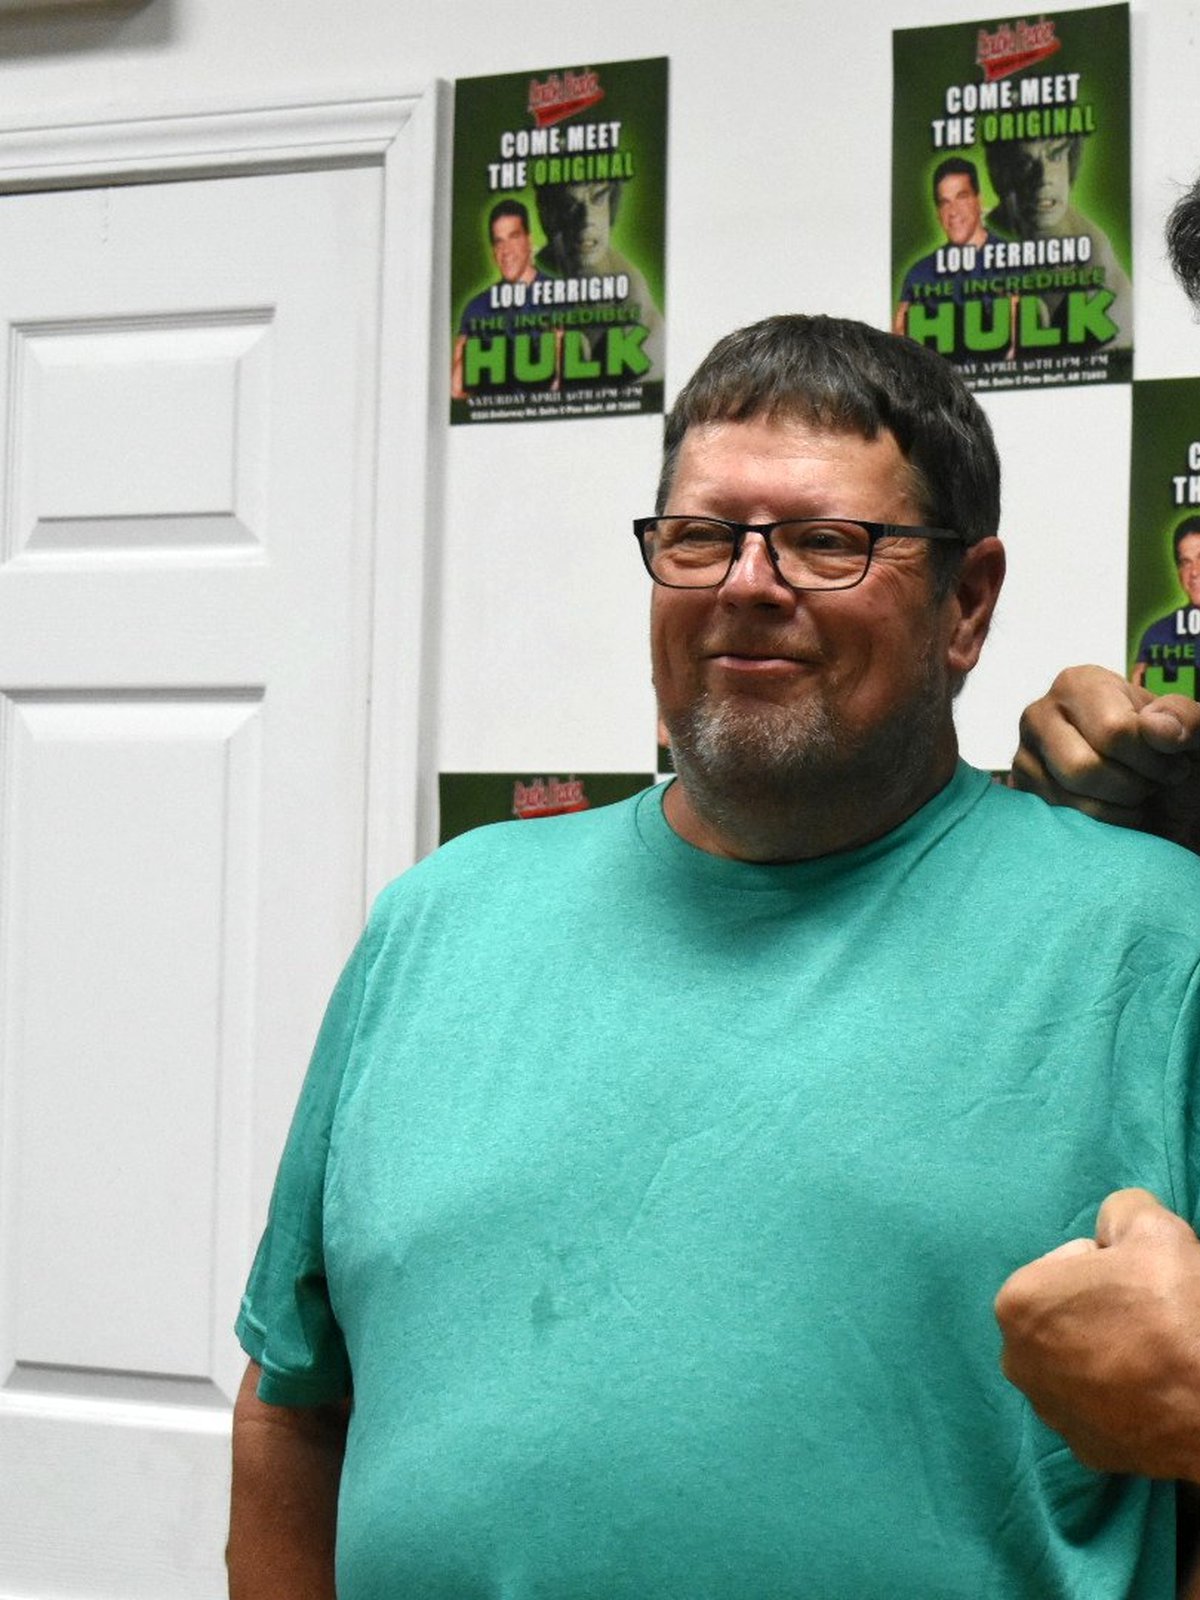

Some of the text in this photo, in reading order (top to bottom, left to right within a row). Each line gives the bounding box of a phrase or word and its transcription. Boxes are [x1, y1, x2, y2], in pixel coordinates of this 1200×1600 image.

[946, 73, 1080, 114] COME MEET
[501, 121, 621, 158] COME MEET
[932, 105, 1095, 147] THE ORIGINAL
[488, 152, 634, 189] THE ORIGINAL
[936, 236, 1091, 274] LOU FERRIGNO
[490, 275, 629, 308] LOU FERRIGNO
[913, 266, 1106, 298] THE INCREDIBLE
[471, 315, 506, 331] THE
[908, 289, 1119, 353] HULK
[465, 325, 651, 386] HULK
[1151, 643, 1195, 659] THE
